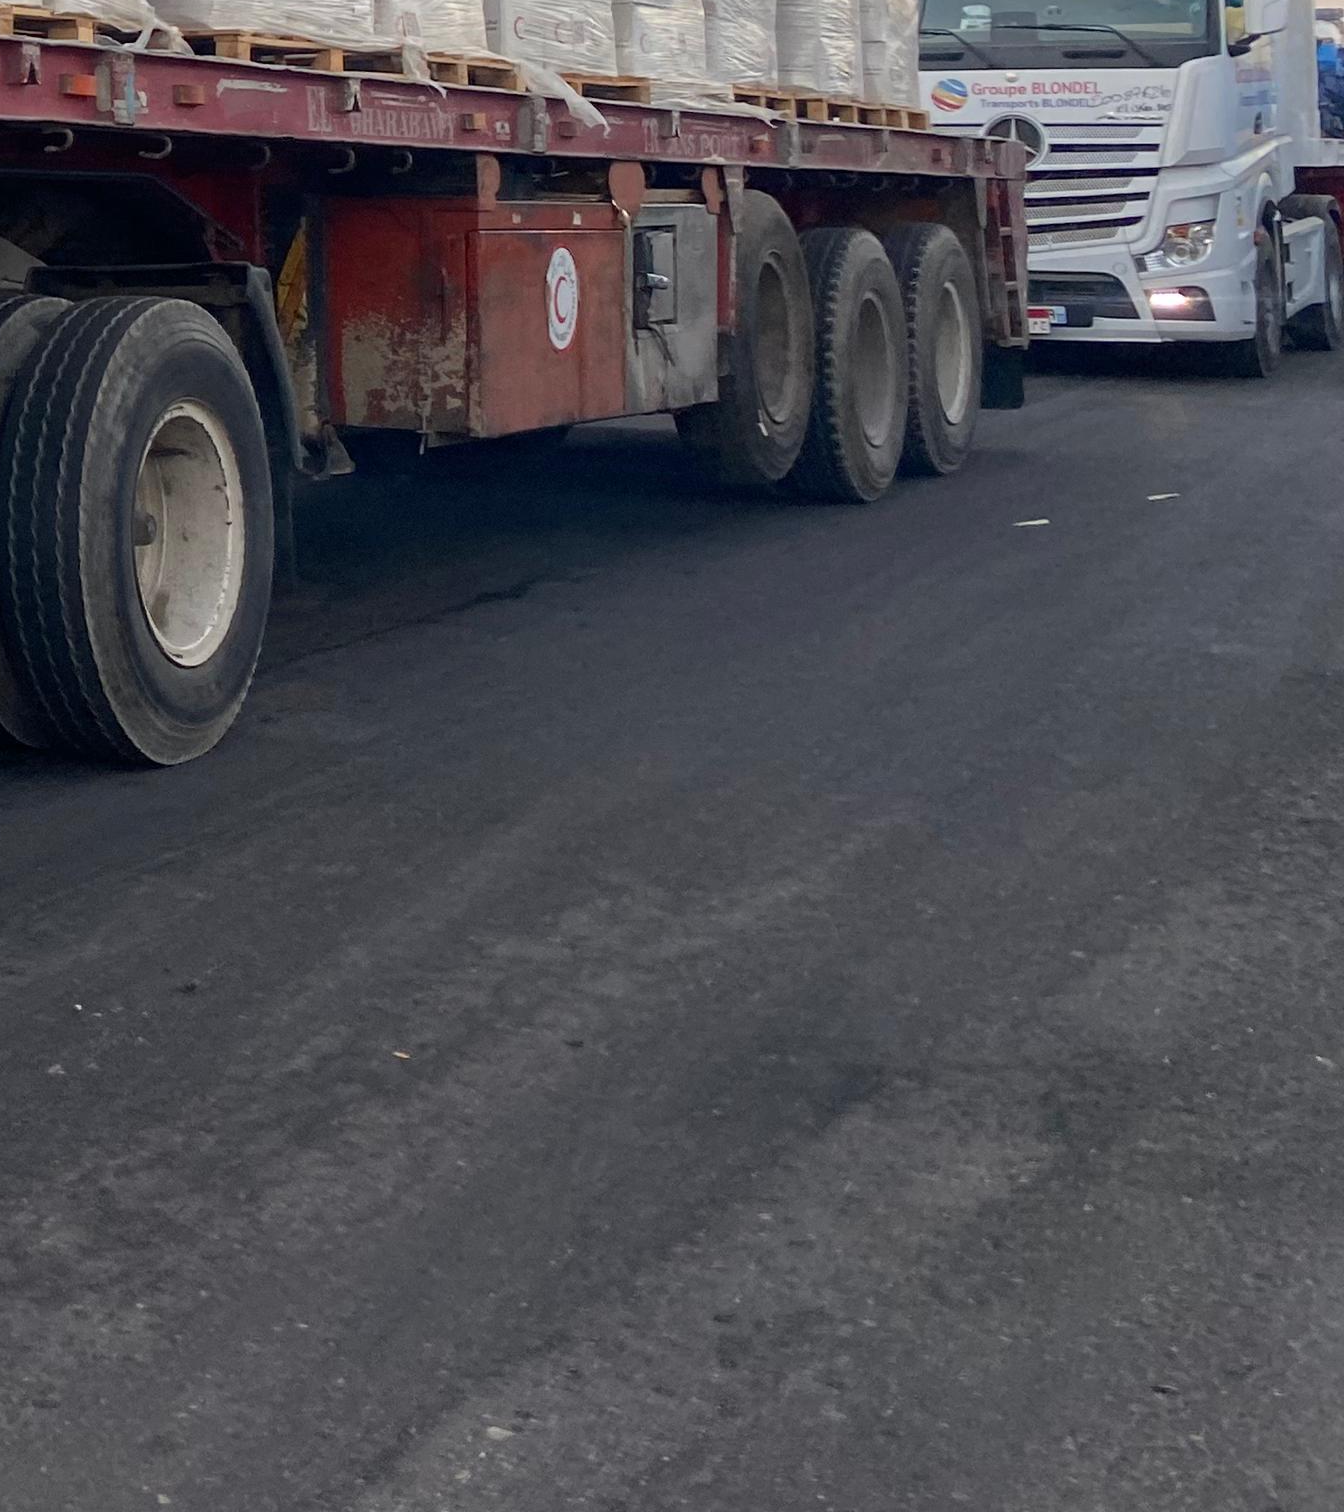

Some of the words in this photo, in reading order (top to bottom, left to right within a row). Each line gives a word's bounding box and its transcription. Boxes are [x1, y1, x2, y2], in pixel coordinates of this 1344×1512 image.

[971, 82, 1027, 97] Groupe
[1032, 81, 1102, 95] BLONDEL
[980, 98, 1040, 109] Transports
[1042, 98, 1092, 108] BLONDEL
